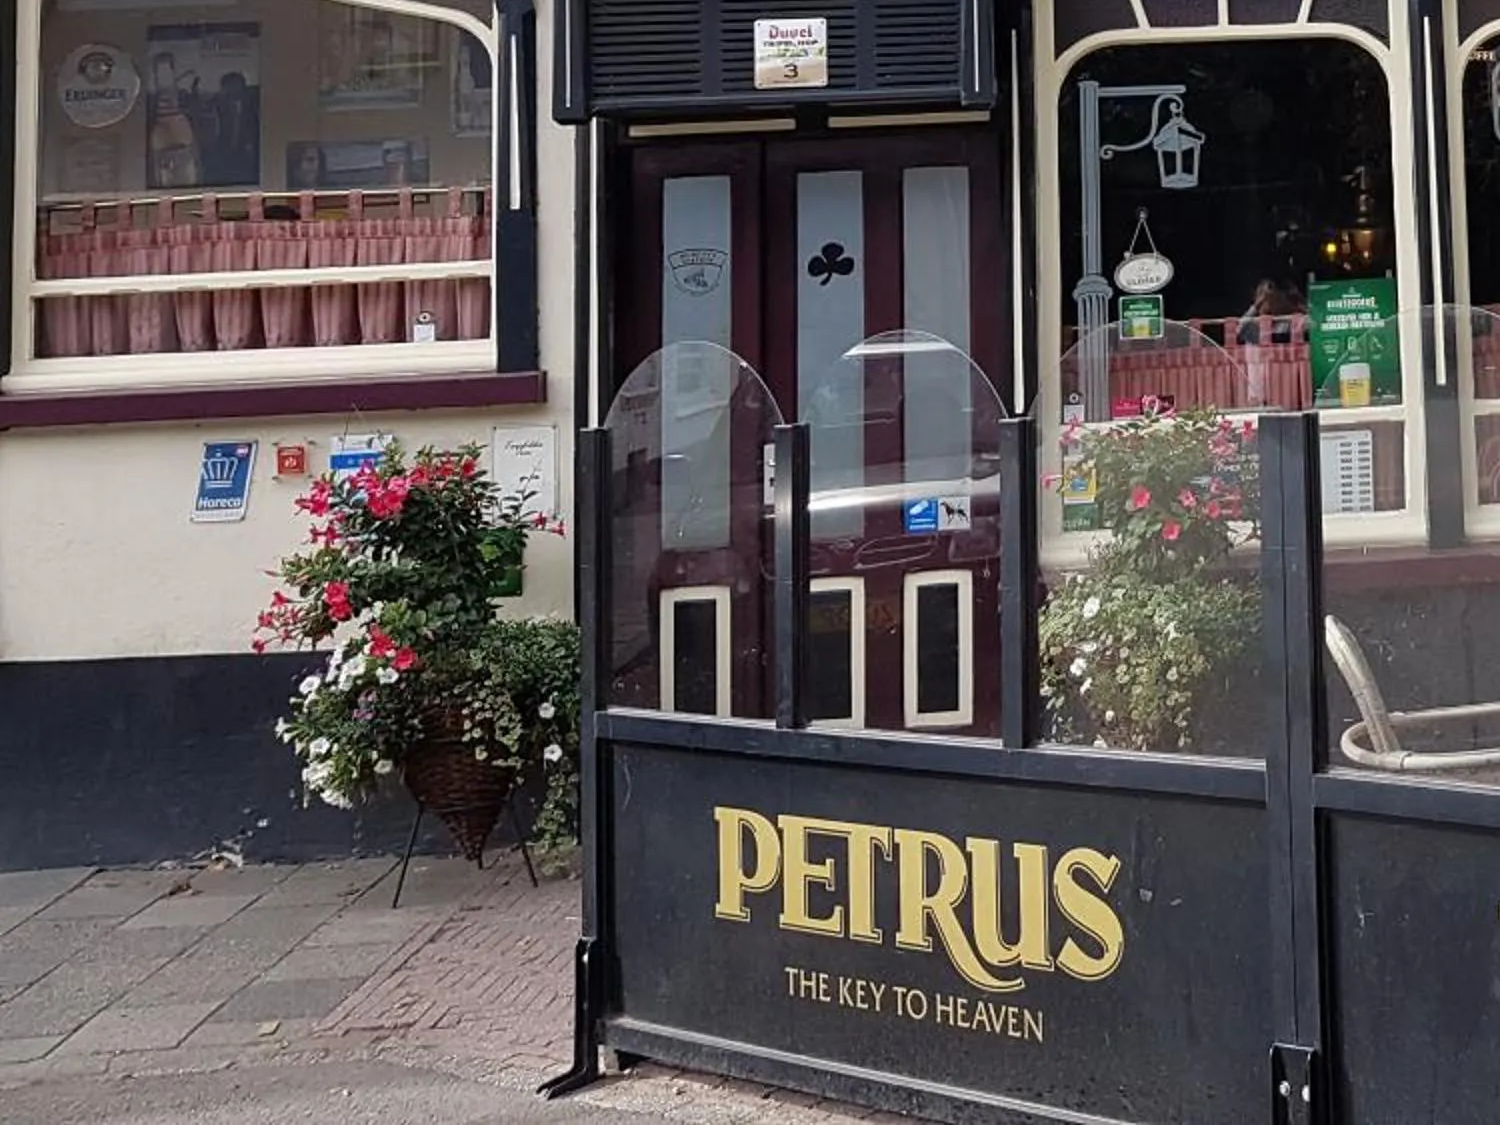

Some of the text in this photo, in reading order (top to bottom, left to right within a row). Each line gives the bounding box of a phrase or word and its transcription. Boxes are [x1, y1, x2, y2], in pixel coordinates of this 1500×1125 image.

[769, 25, 812, 39] Duvel
[783, 62, 799, 79] 3
[198, 495, 242, 508] Horeca
[713, 806, 1126, 992] PETRUS
[784, 967, 1044, 1044] THE KEY TO HEAVEN
